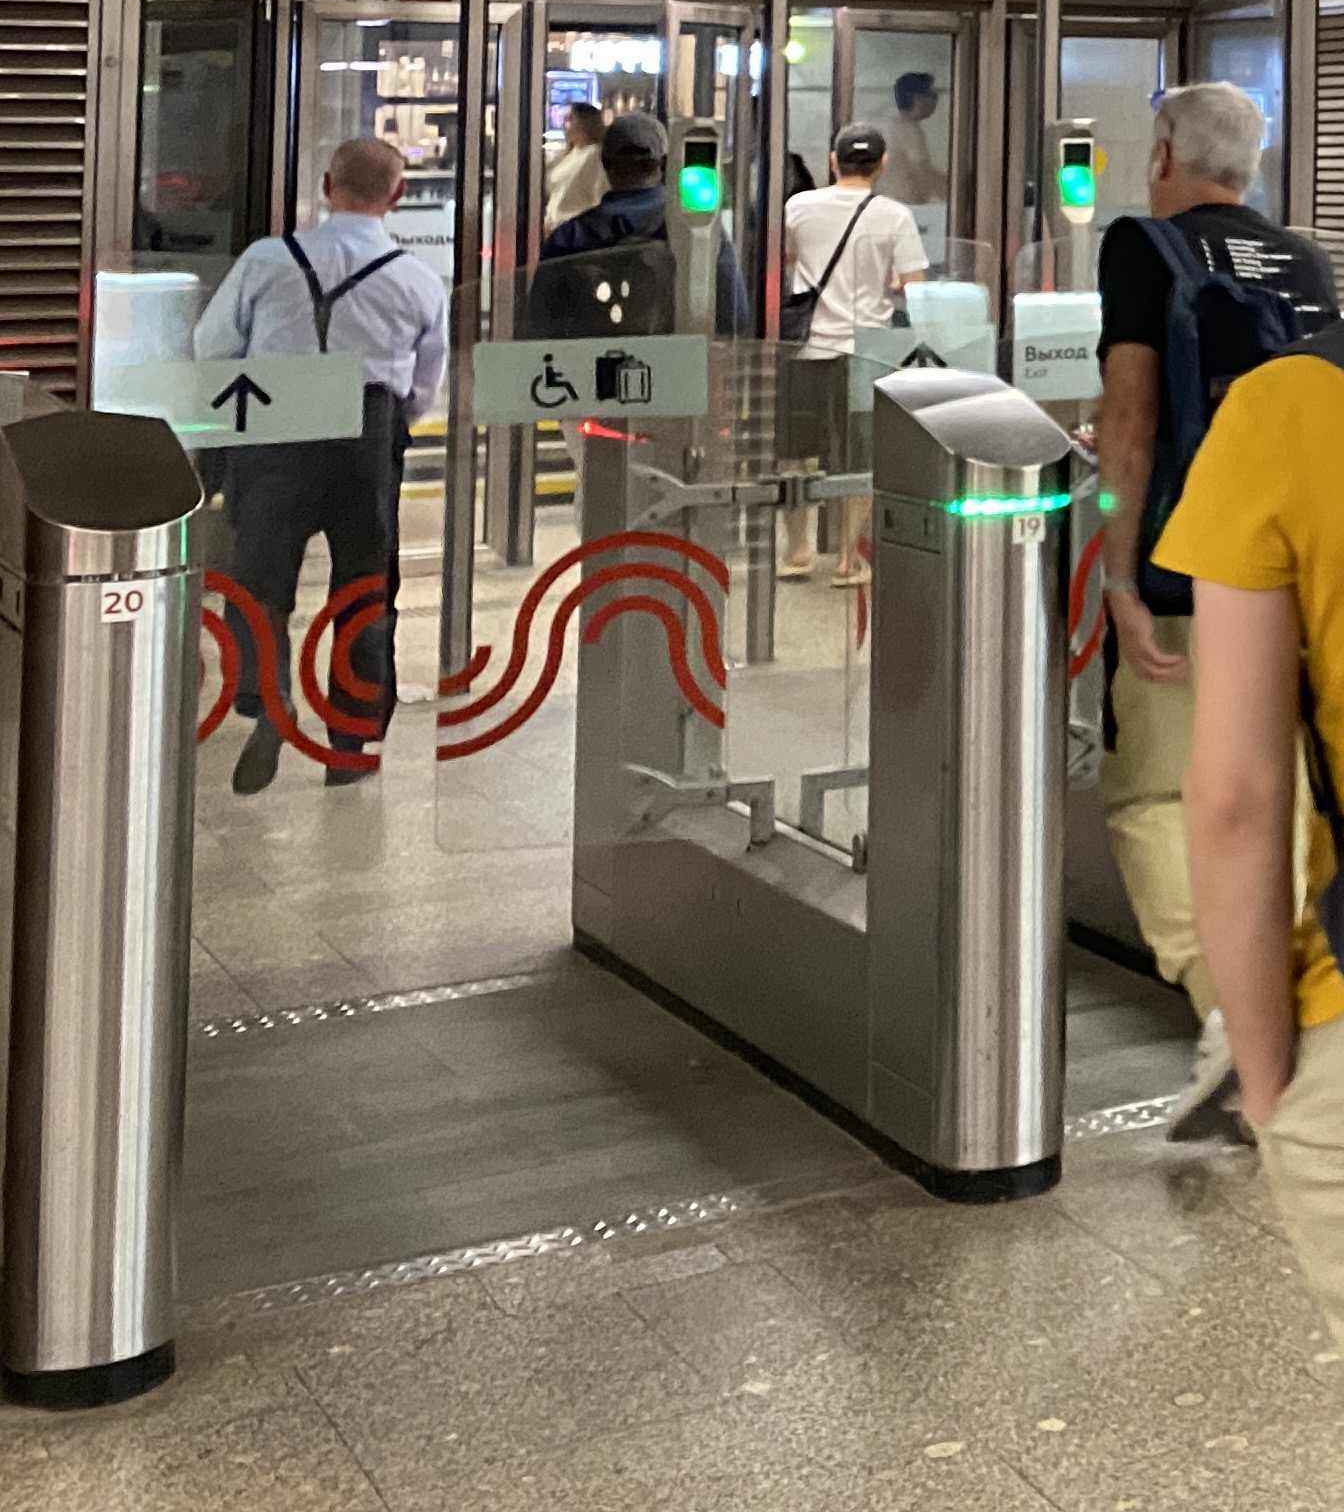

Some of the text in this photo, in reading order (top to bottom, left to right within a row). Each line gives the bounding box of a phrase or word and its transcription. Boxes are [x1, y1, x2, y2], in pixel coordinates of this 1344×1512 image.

[1024, 345, 1089, 362] Выход
[1018, 516, 1041, 537] 19
[104, 590, 144, 615] 20
